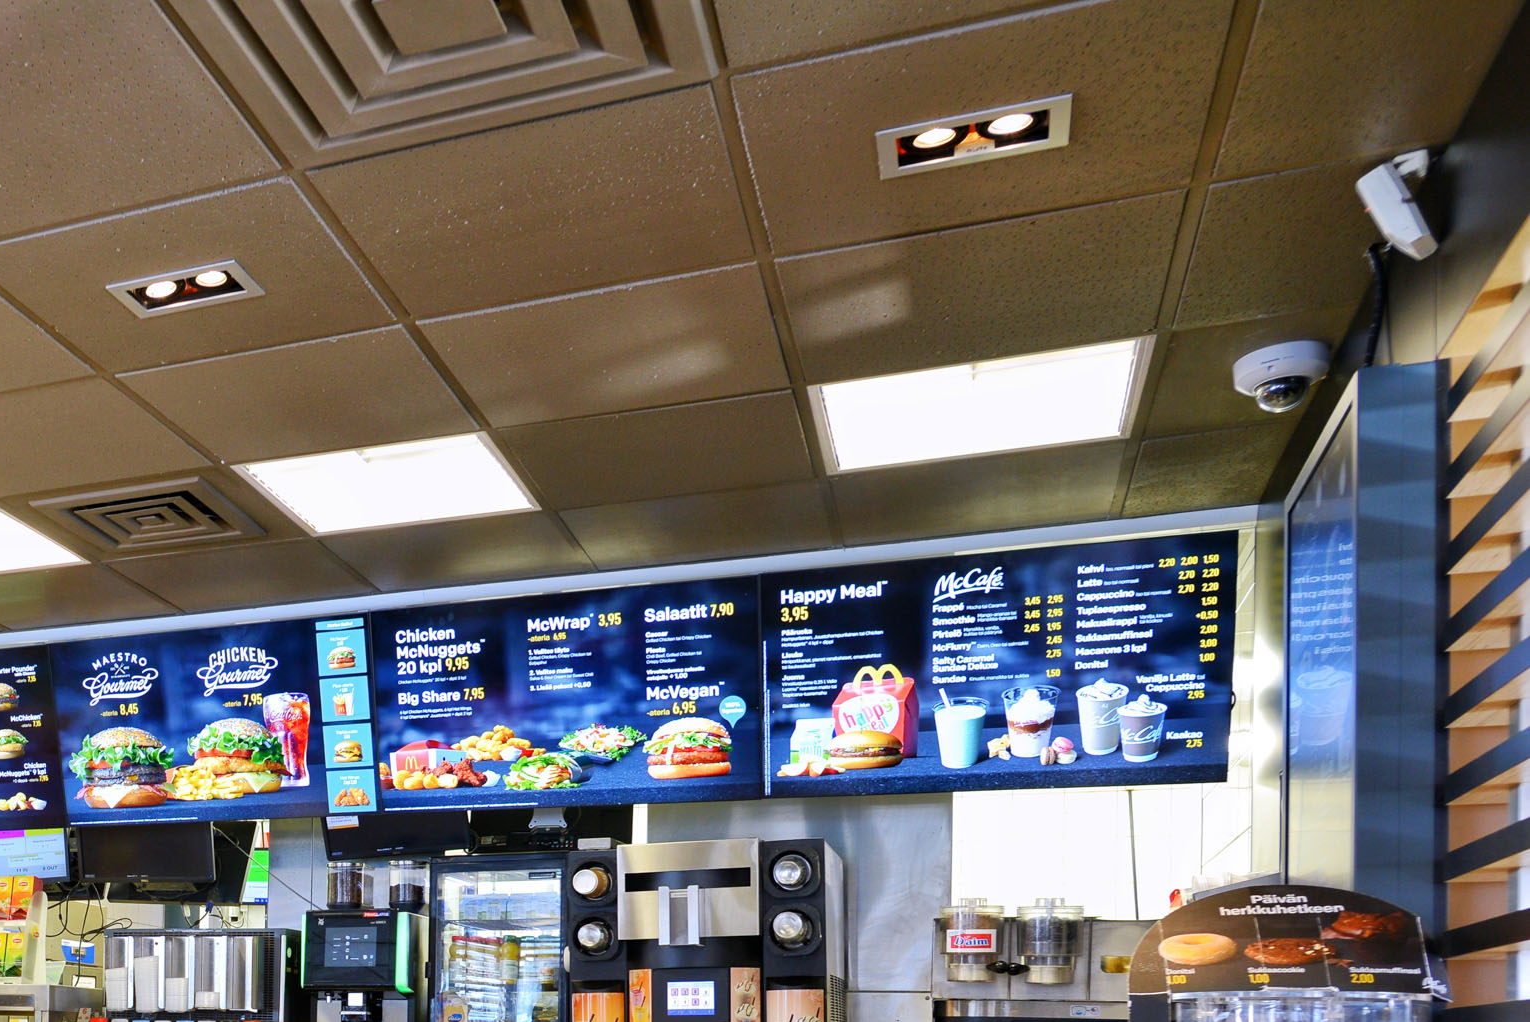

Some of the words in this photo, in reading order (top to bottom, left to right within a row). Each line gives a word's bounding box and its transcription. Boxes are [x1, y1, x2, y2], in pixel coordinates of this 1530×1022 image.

[1158, 558, 1176, 568] 2,20
[1181, 556, 1198, 566] 2,00
[1203, 554, 1220, 564] 1,50
[1077, 564, 1105, 575] Kahvi
[1178, 570, 1195, 580] 2,70
[1202, 568, 1220, 578] 2,20
[1077, 578, 1103, 588] Latte
[1178, 584, 1195, 594] 2,70
[1202, 582, 1219, 592] 2,20
[780, 589, 837, 605] Happy
[840, 581, 882, 600] Meal
[1077, 589, 1135, 602] Cappuccino
[1024, 596, 1041, 606] 3,45
[1047, 594, 1064, 604] 2,95
[1201, 596, 1218, 606] 1,50
[644, 604, 708, 623] Salaatit
[710, 602, 734, 618] 7,90
[932, 602, 965, 613] Frappé
[1076, 603, 1147, 616] Tuplaespresso
[780, 605, 809, 623] 3,95
[1024, 610, 1041, 620] 3,45
[1047, 608, 1063, 618] 2,95
[527, 616, 590, 633] McWrap
[598, 612, 622, 627] 3,95
[932, 615, 976, 626] Smoothie
[1024, 624, 1040, 633] 2,45
[1047, 622, 1062, 631] 1,95
[1200, 624, 1218, 635] 2,00
[395, 627, 455, 644] Chicken
[553, 632, 567, 641] 6,95
[1046, 635, 1063, 645] 2,45
[1075, 645, 1122, 656] Macarons
[1123, 645, 1130, 653] 3
[1131, 643, 1147, 653] kpl
[1199, 638, 1218, 649] 3,00
[396, 641, 481, 659] McNuggets
[1046, 649, 1062, 659] 2,75
[91, 652, 148, 671] MAESTRO
[209, 646, 267, 667] CHICKEN
[932, 657, 956, 666] Salty
[956, 653, 995, 664] Caramel
[1199, 653, 1216, 662] 1,00
[11, 665, 35, 673] Pounder
[397, 661, 417, 675] 20
[419, 658, 442, 676] kpl
[445, 656, 470, 672] 9,95
[932, 663, 966, 673] Sundae
[968, 660, 999, 671] Deluxe
[1075, 660, 1109, 670] Donitsi
[196, 657, 278, 697] Gourmet
[932, 674, 967, 684] Sundae
[1046, 668, 1061, 678] 1,50
[1136, 674, 1169, 684] Vanilja
[1170, 673, 1196, 682] Latte
[82, 668, 159, 706] Gourmet
[646, 684, 720, 701] McVegan
[1146, 682, 1206, 693] Cappuccino
[243, 693, 263, 707] 7,95
[398, 691, 419, 706] Big
[422, 690, 461, 703] Share
[463, 687, 485, 701] 7,95
[1187, 690, 1205, 700] 2,95
[119, 703, 139, 716] 8,45
[672, 701, 697, 716] 6,95
[843, 698, 893, 728] happy
[10, 714, 41, 722] McChicken
[1166, 730, 1203, 740] Kaakao
[1186, 739, 1203, 749] 2,75
[1250, 893, 1308, 906] Päivän
[1219, 903, 1345, 917] herkkuhetkeen
[954, 936, 989, 946] Daim
